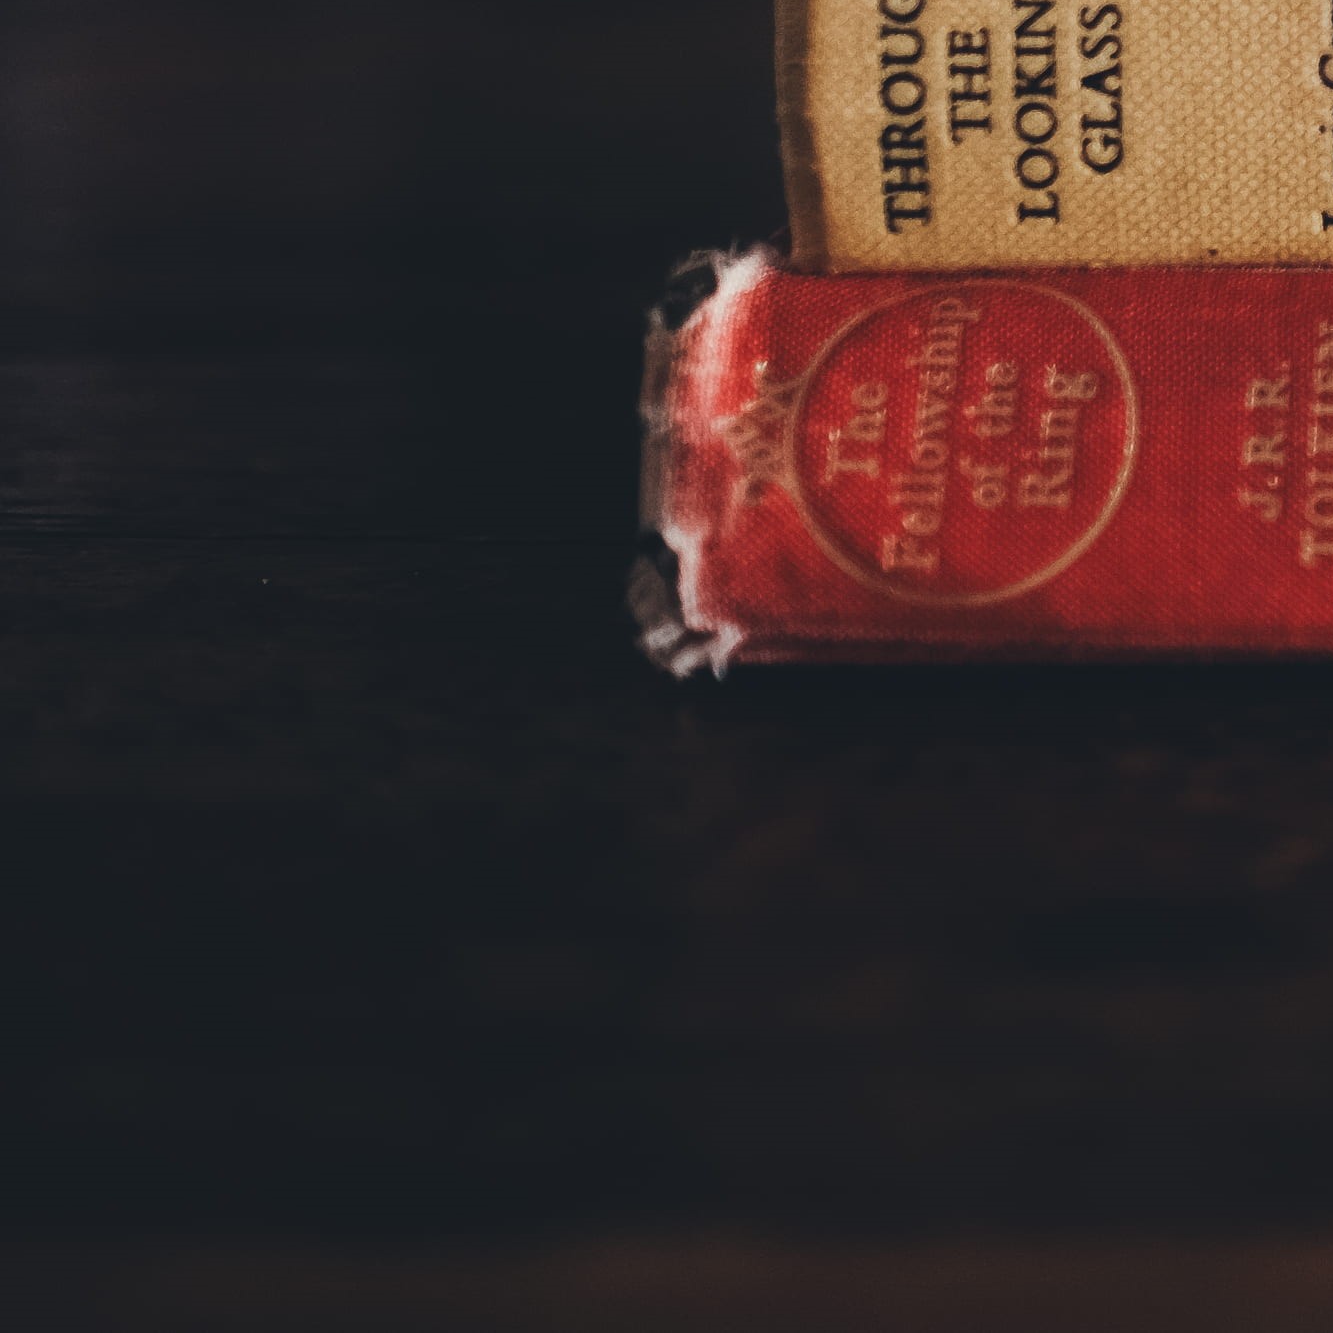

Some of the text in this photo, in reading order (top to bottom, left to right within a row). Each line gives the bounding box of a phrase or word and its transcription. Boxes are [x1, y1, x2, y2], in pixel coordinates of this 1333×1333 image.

[945, 28, 993, 143] THE
[1078, 1, 1124, 175] GLASS
[822, 381, 891, 481] The
[881, 294, 982, 572] Fellowship
[965, 360, 1019, 510] of the
[1018, 363, 1102, 510] Ring
